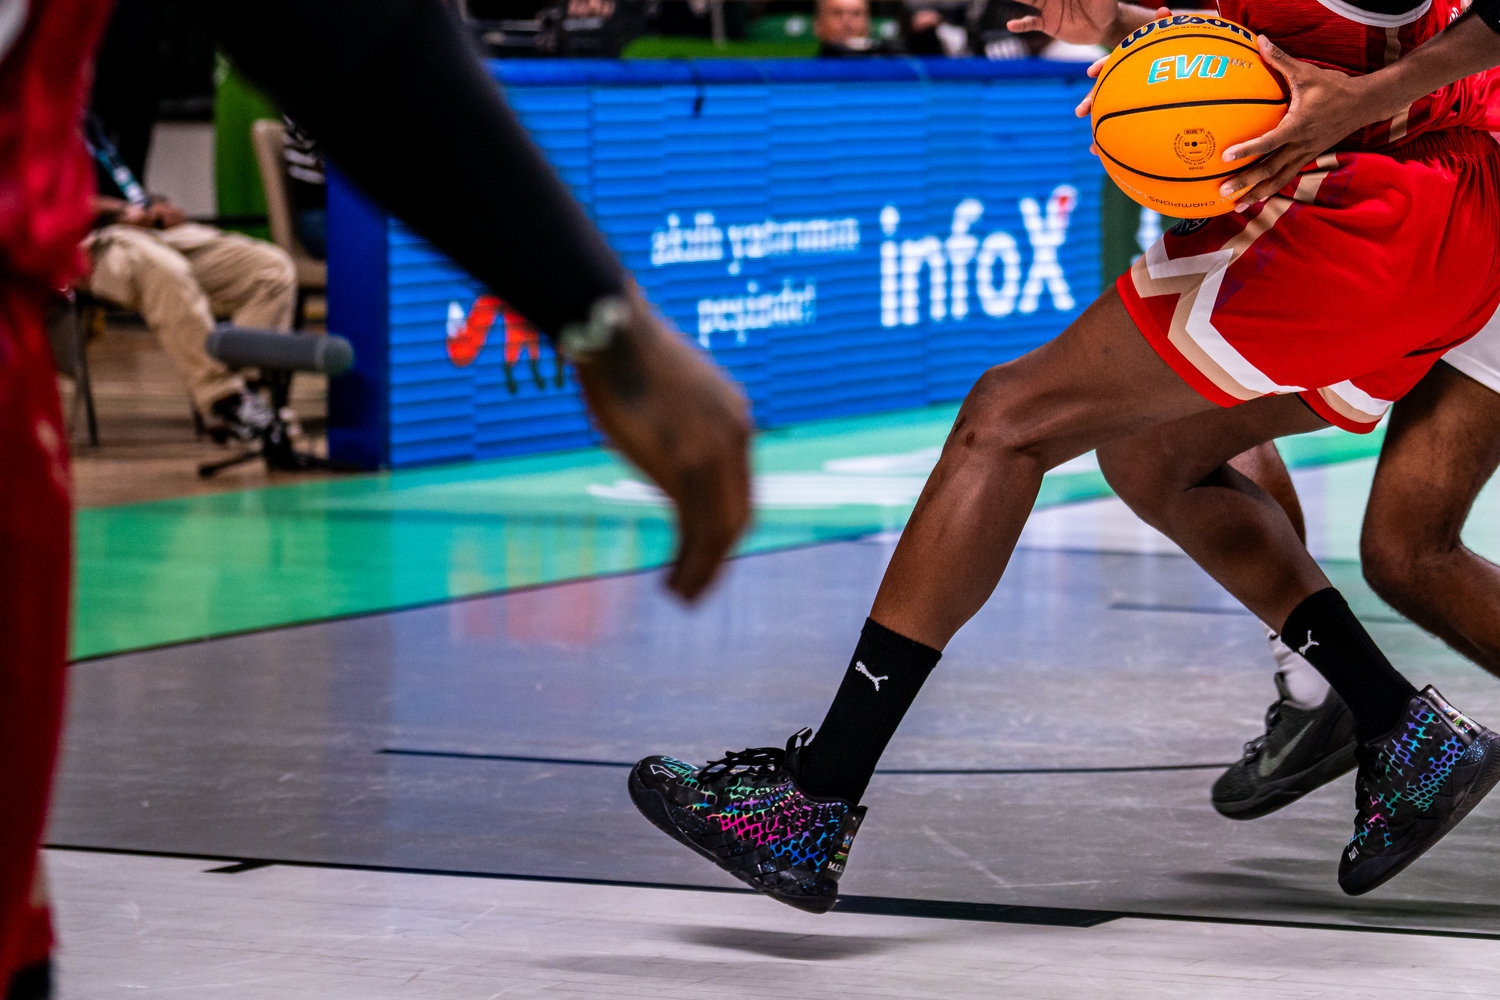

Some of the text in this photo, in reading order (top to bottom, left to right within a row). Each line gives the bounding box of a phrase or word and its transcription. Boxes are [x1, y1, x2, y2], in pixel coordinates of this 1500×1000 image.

[1147, 53, 1254, 85] EVO NXT
[1148, 195, 1216, 209] CHAMPIONS
[879, 184, 1078, 328] infoX
